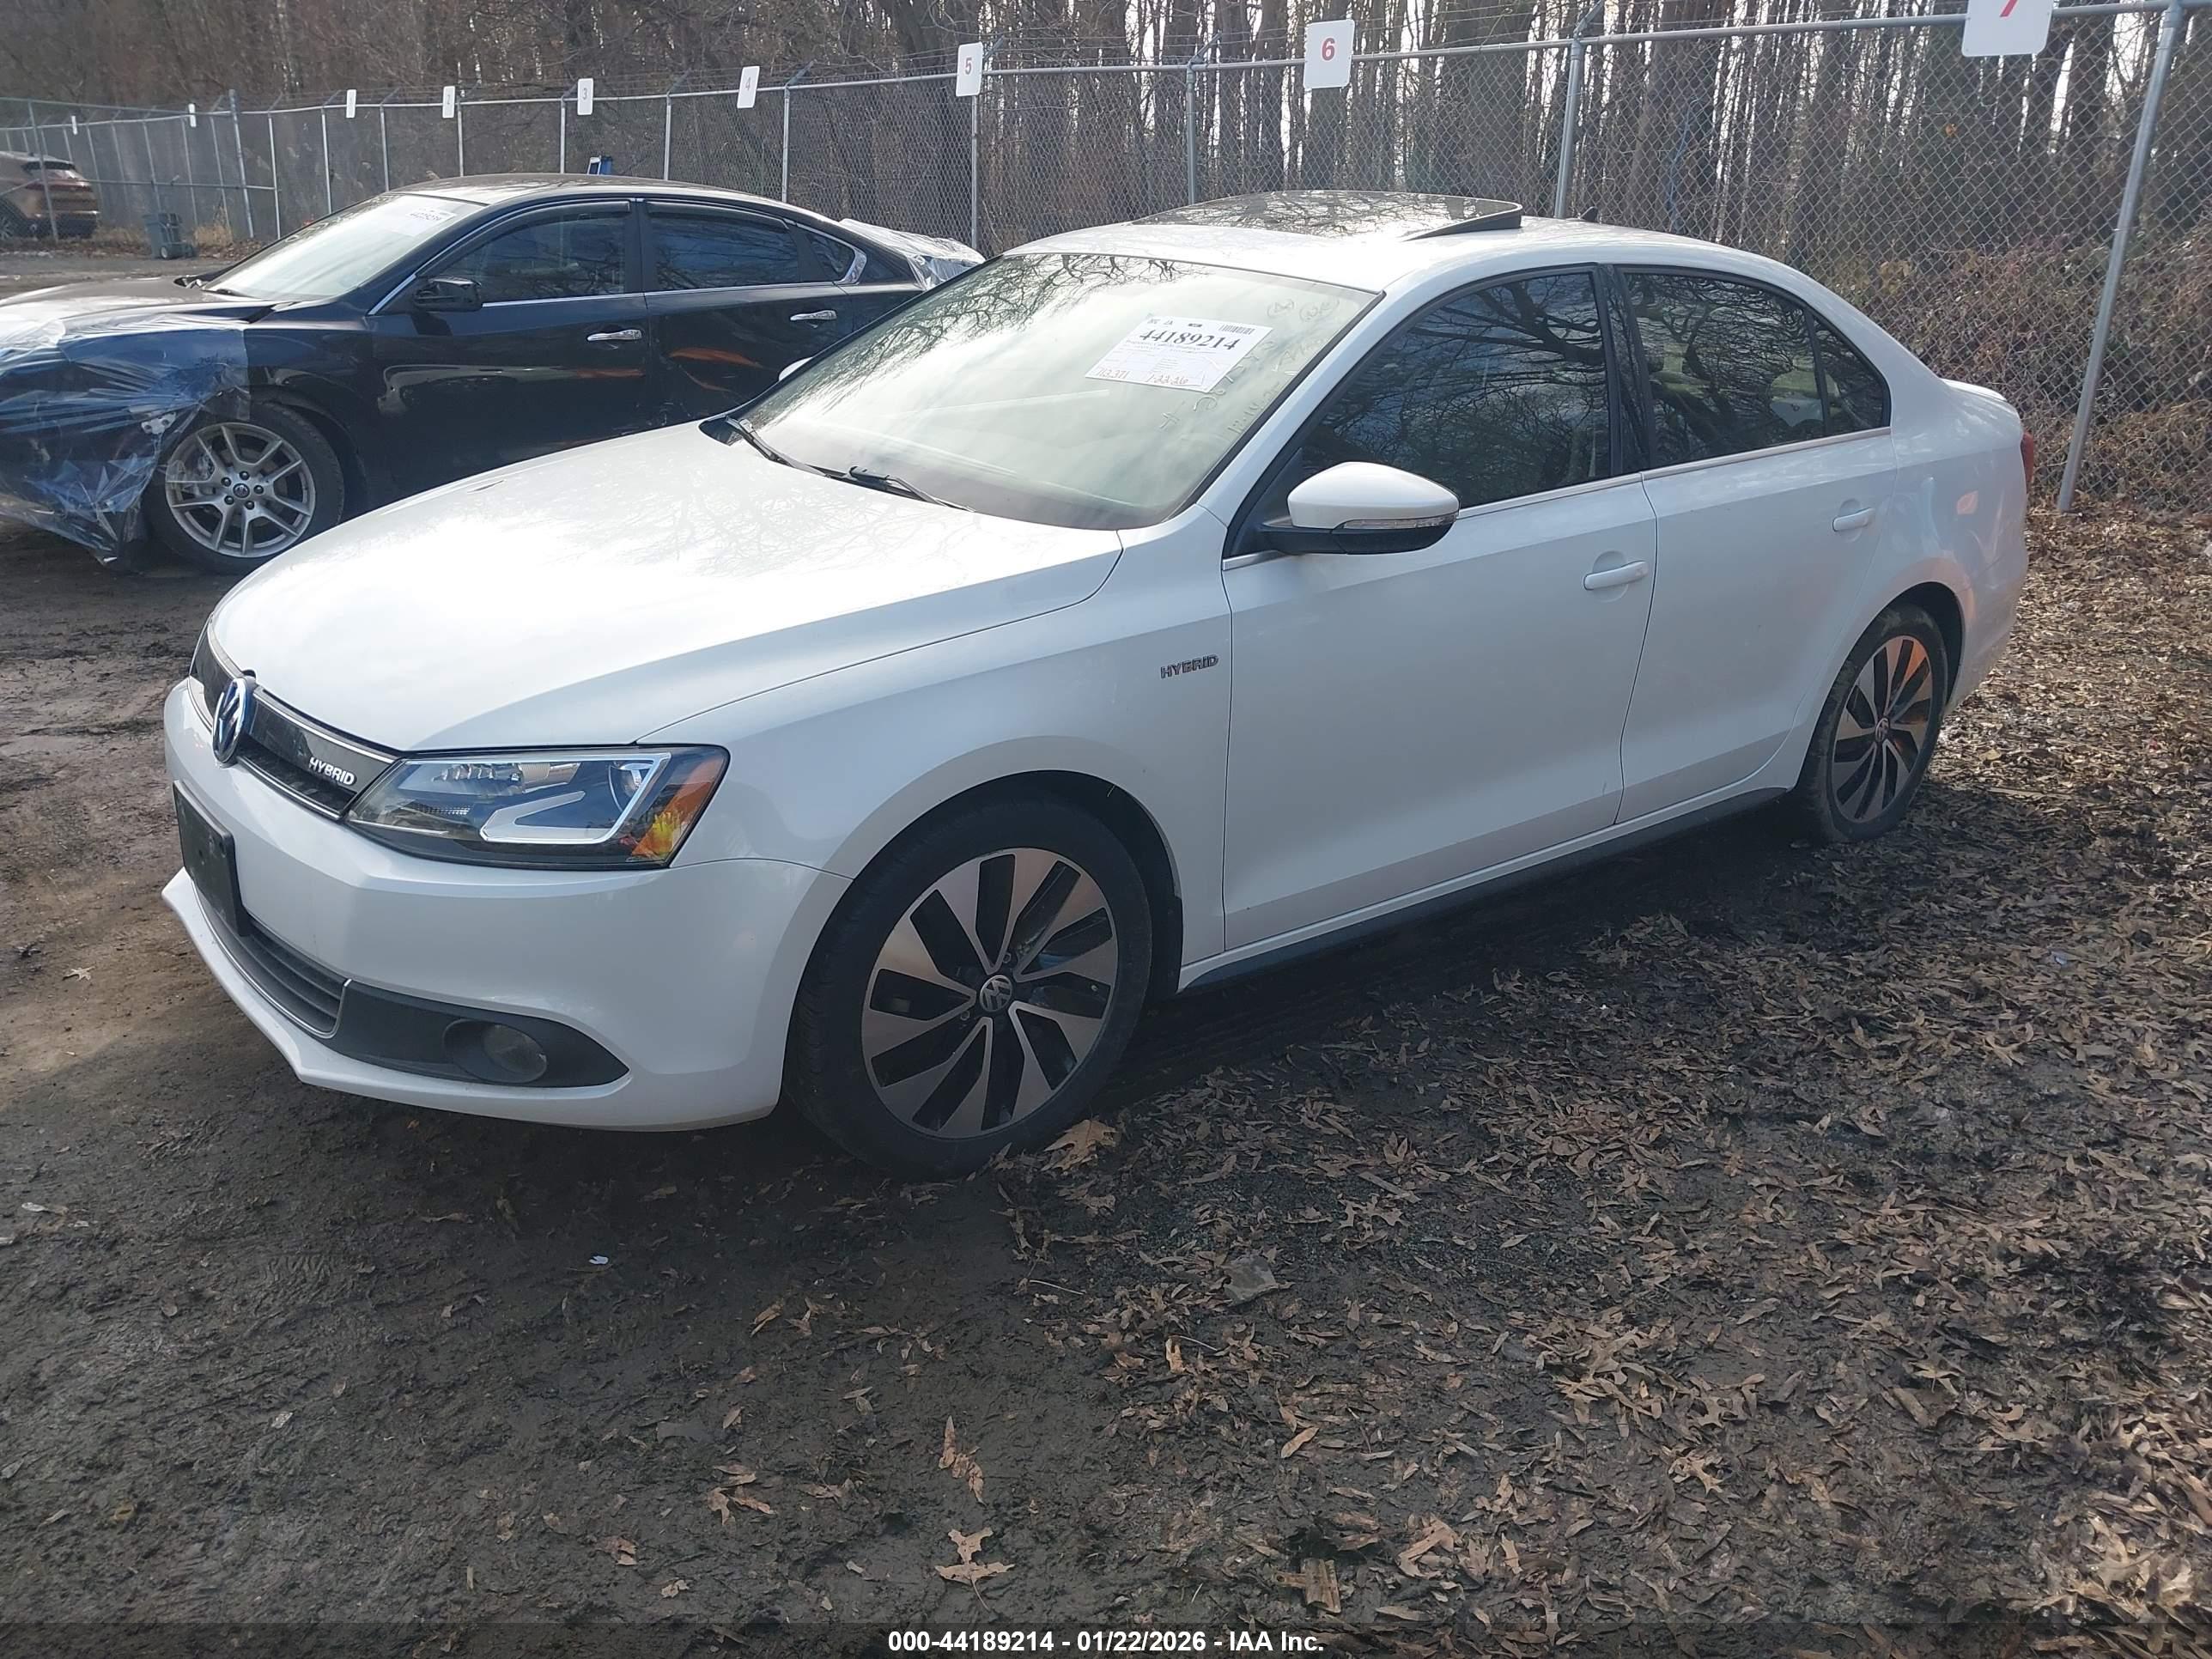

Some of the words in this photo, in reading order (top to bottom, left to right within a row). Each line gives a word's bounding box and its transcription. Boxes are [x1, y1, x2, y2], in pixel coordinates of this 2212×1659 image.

[1322, 37, 1335, 61] 6
[965, 57, 972, 75] 5
[582, 87, 588, 100] 3
[744, 76, 751, 92] 4
[1139, 329, 1242, 350] 44189214
[1160, 654, 1218, 679] HYBRID
[308, 756, 357, 787] HYBRID
